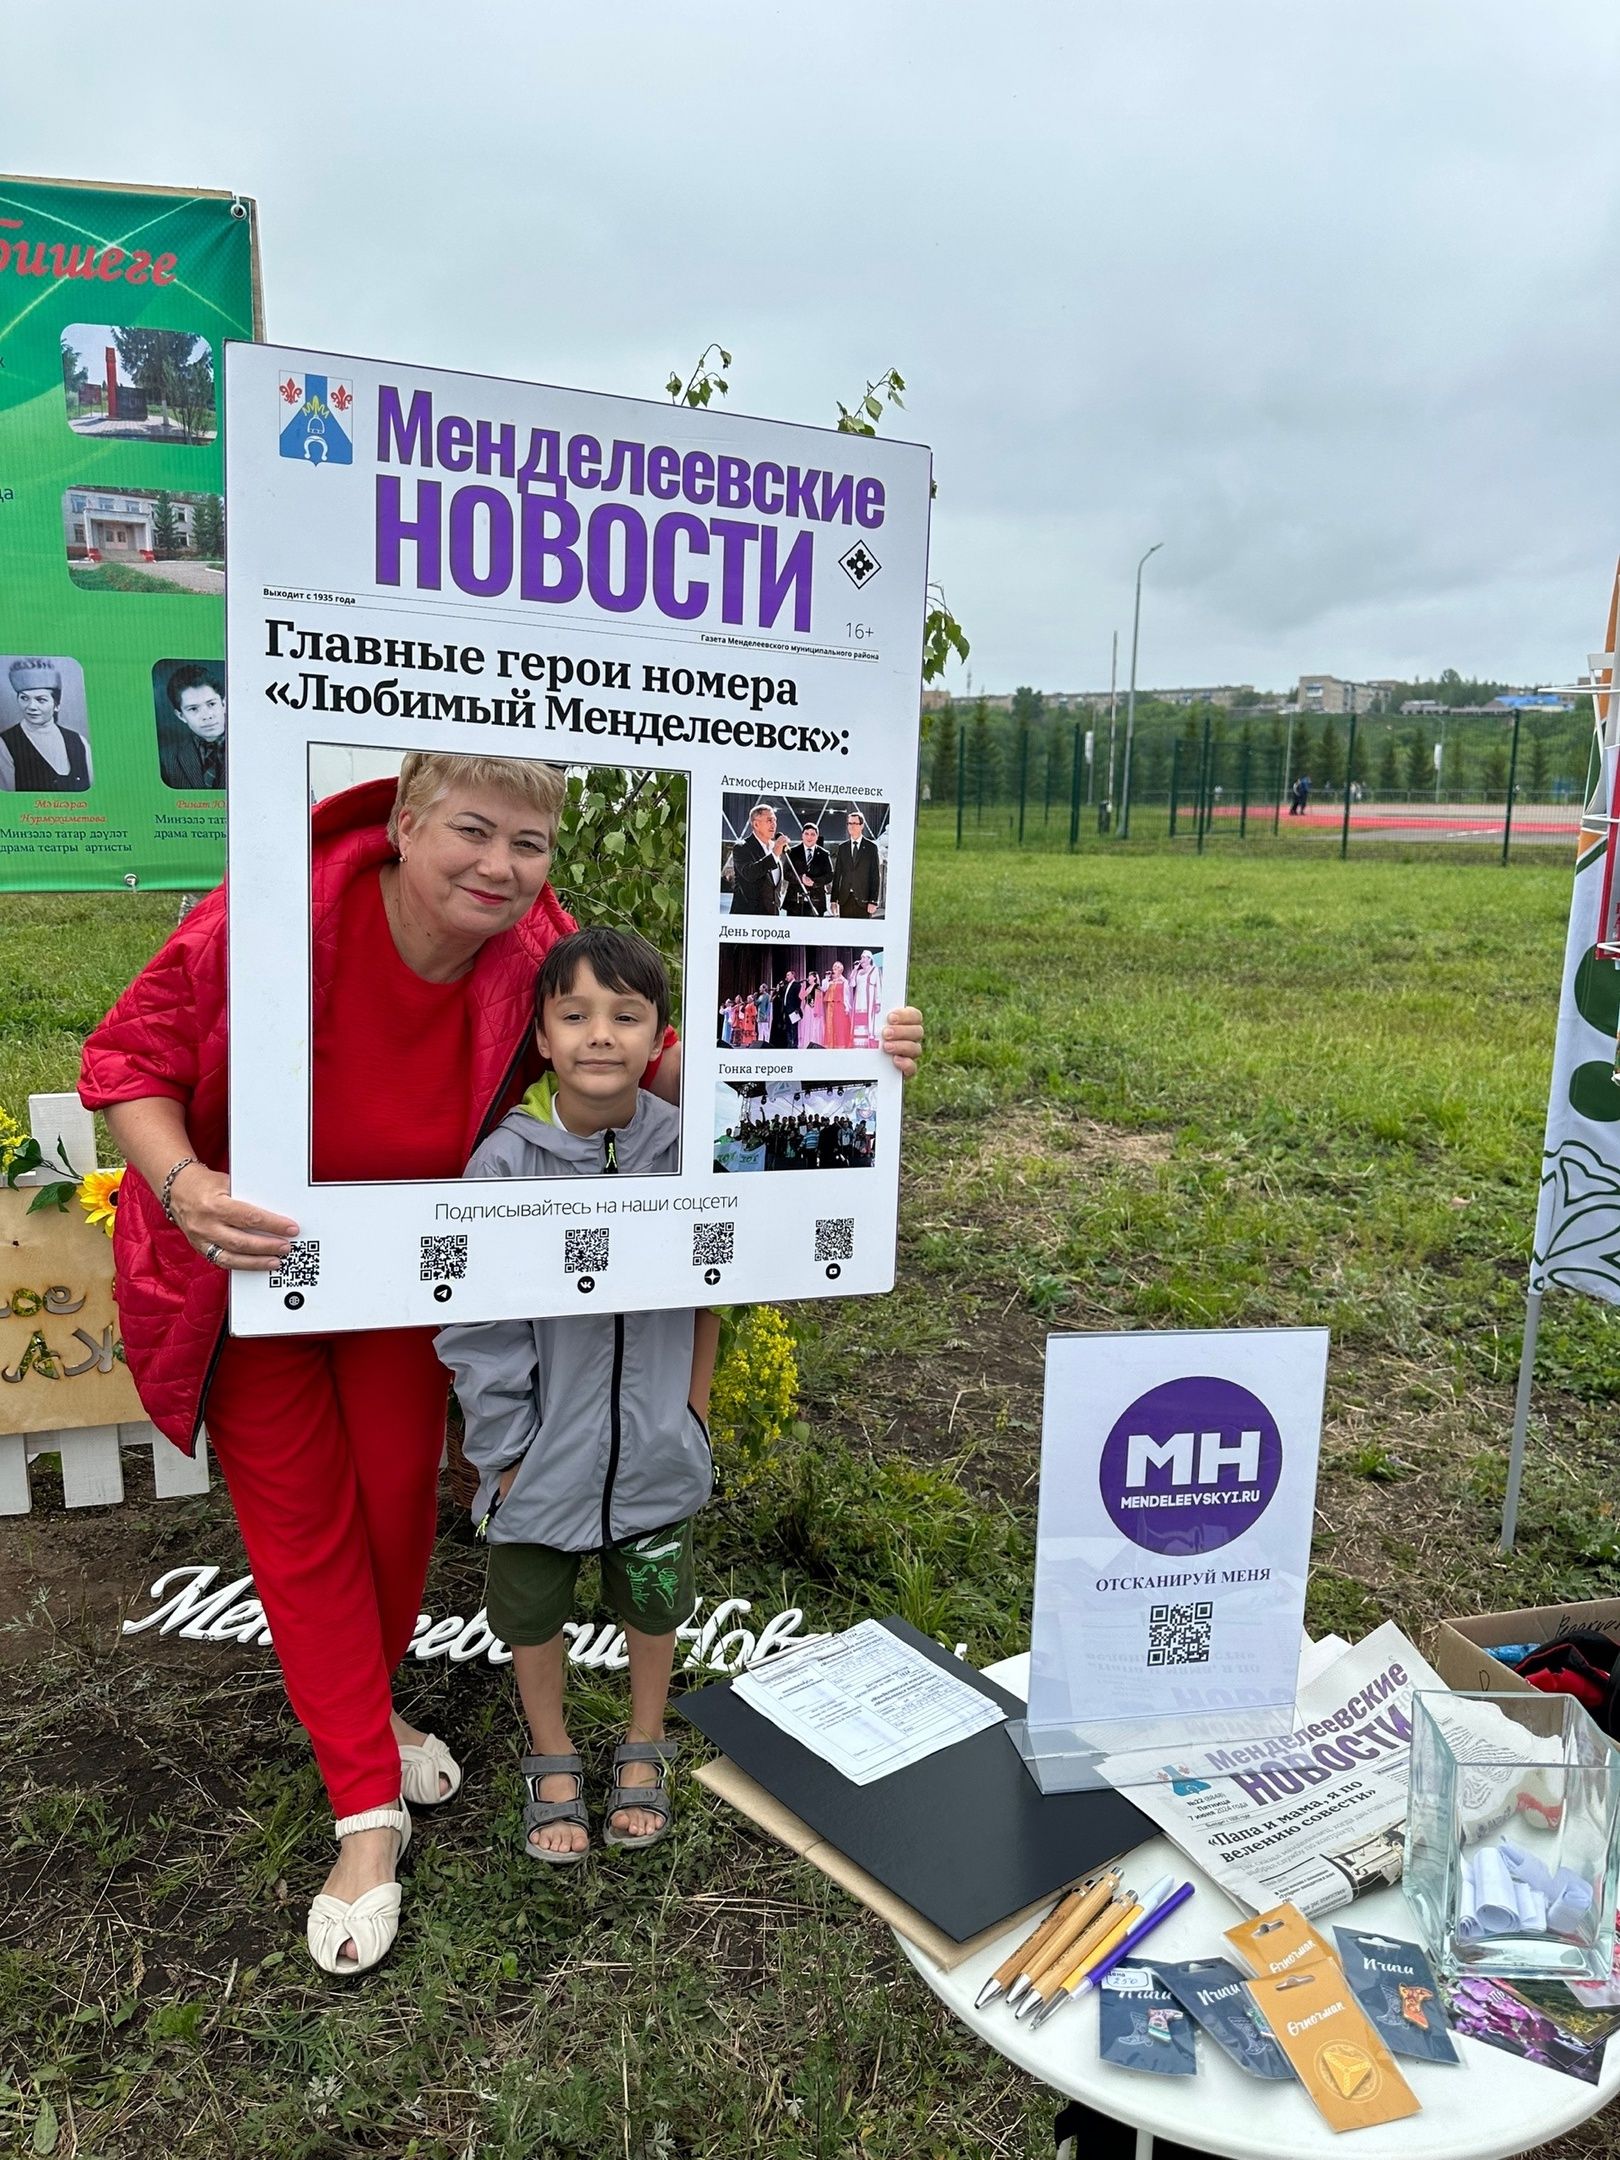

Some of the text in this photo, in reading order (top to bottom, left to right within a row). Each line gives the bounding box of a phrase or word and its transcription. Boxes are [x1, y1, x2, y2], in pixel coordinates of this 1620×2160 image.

[377, 385, 886, 529] Менделеевские
[375, 474, 814, 633] НОВОСТИ
[263, 588, 304, 600] Выходит
[313, 593, 334, 602] 1935
[335, 596, 356, 605] года
[846, 622, 874, 640] 16+
[701, 634, 879, 661] Газета Менделеевского муниципального района
[265, 618, 798, 711] Главные герои номера
[265, 672, 849, 755] «Любимый Менделеевск»:
[721, 775, 883, 797] Атмосферный Менделеевск
[55, 830, 87, 841] татар
[154, 829, 188, 840] драма
[38, 844, 79, 854] театры
[85, 843, 132, 854] артисты
[719, 926, 791, 939] День города
[718, 1064, 793, 1075] Гонка героев
[435, 1194, 738, 1222] Подписывайтесь на наши соцсети
[1120, 1489, 1260, 1510] MENDELEEVSKYI.RU
[1095, 1567, 1271, 1592] ОТСКАНИРУЙ МЕНЯ
[1204, 1663, 1408, 1771] Менделеевские
[1229, 1703, 1413, 1806] НОВОСТИ
[1197, 1800, 1231, 1811] Пятница
[1208, 1826, 1263, 1847] «Папа
[1262, 1820, 1279, 1831] и
[1277, 1798, 1329, 1825] мама,
[1326, 1792, 1341, 1804] я
[1340, 1781, 1363, 1796] по
[1220, 1789, 1377, 1863] велению совести»
